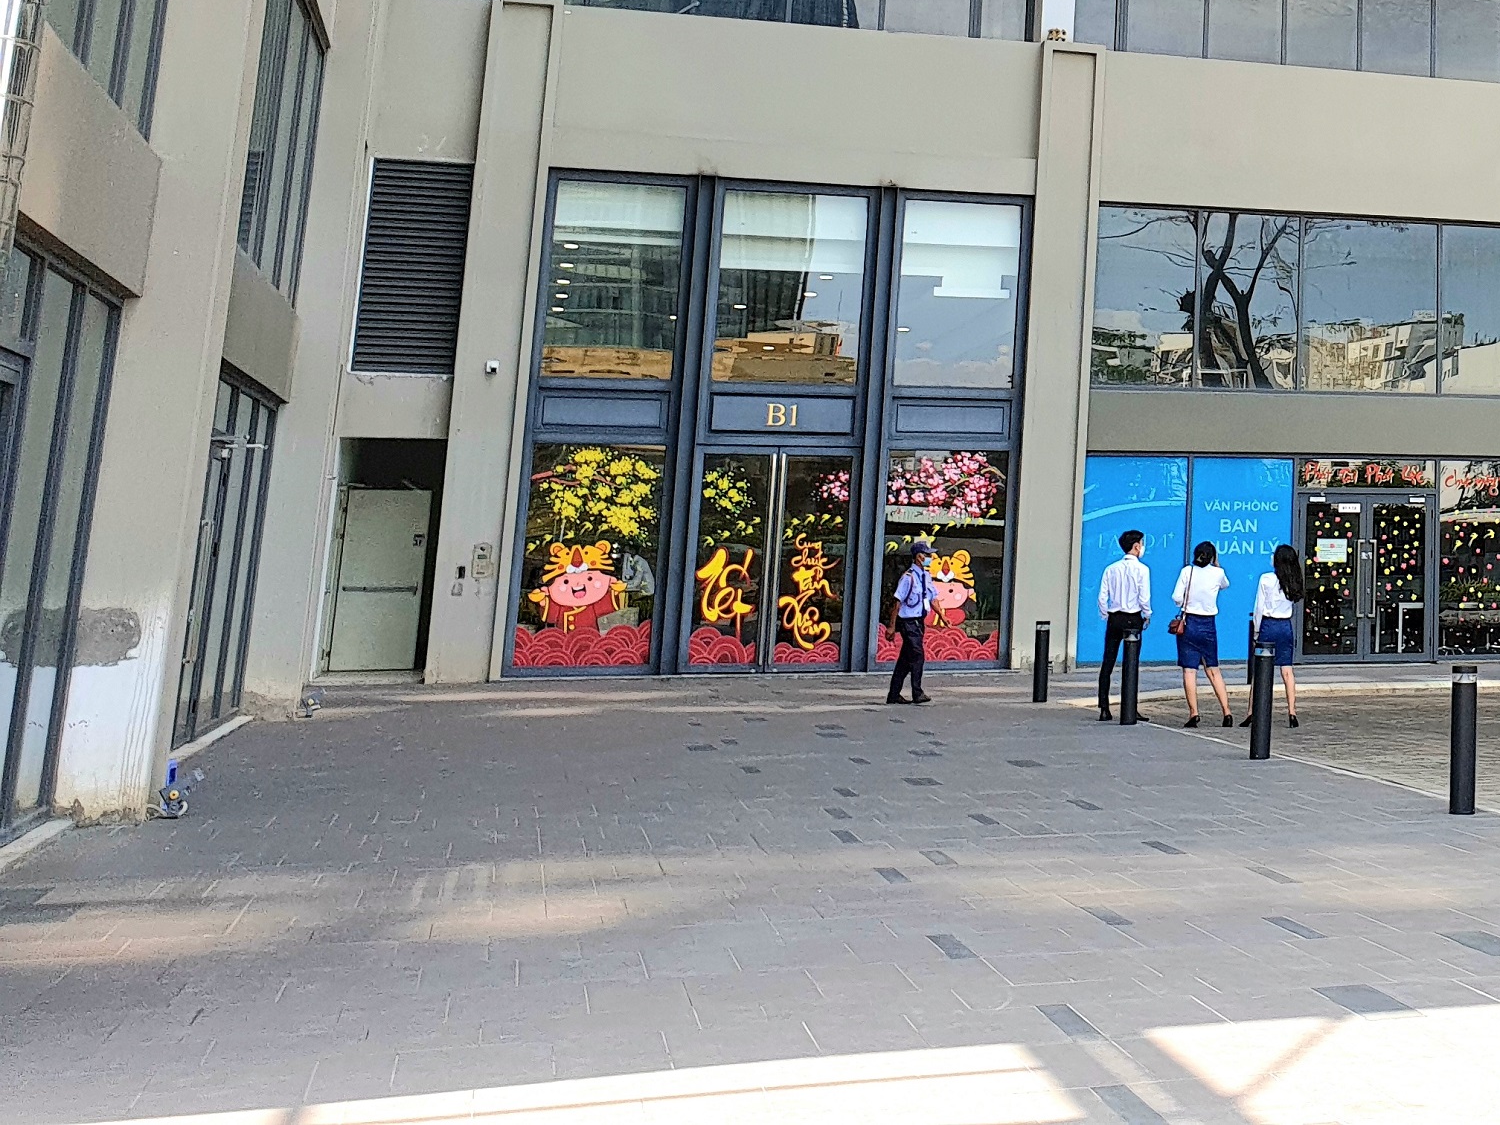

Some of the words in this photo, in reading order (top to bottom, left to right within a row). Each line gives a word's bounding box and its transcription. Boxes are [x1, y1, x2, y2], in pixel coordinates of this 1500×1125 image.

[765, 402, 799, 428] B1
[1204, 498, 1231, 512] VĂN
[1233, 498, 1279, 512] PHÒNG
[1219, 518, 1258, 533] BAN
[1209, 536, 1254, 555] UẢN
